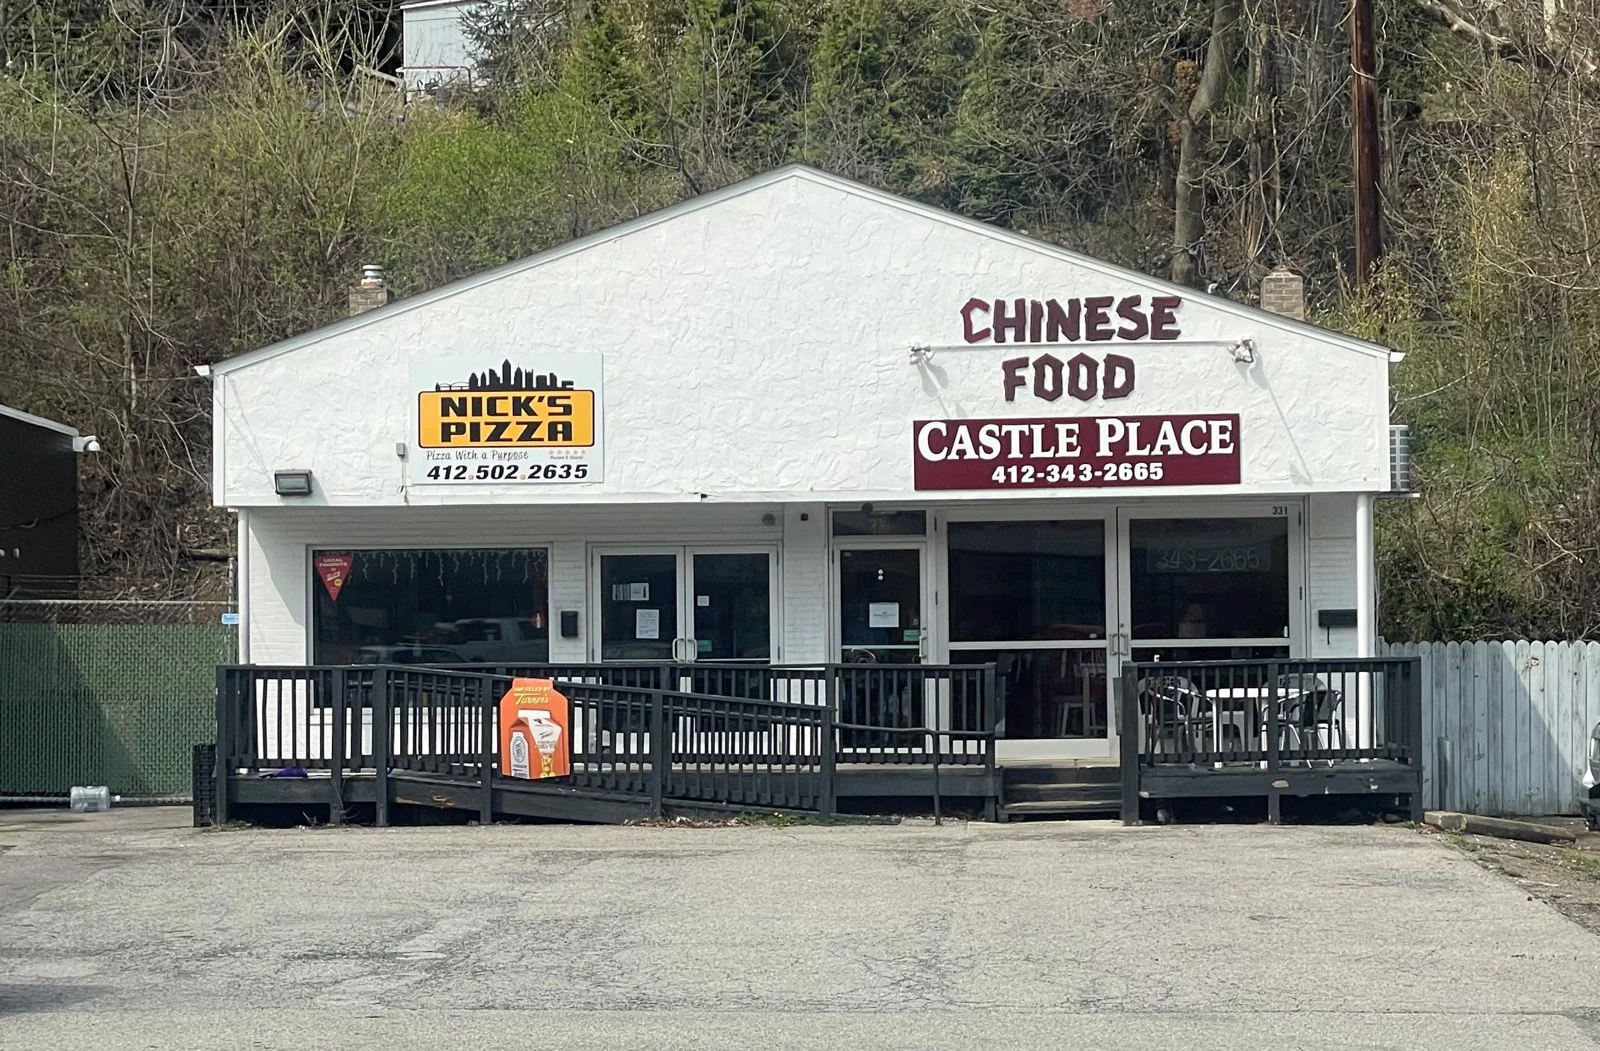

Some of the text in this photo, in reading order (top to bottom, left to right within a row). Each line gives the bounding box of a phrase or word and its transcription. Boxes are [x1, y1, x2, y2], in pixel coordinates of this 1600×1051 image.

[960, 295, 1182, 343] CHINESE
[1002, 353, 1136, 402] FOOD
[441, 396, 573, 417] NICK'S
[441, 421, 573, 442] PIZZA
[917, 417, 1234, 461] CASTLE PLACE
[426, 450, 529, 461] Pizza With a Purpose
[426, 464, 588, 480] 412.502.2635
[991, 462, 1164, 484] 412-343-2665
[1272, 506, 1288, 515] 331
[1156, 547, 1260, 571] 343-2665
